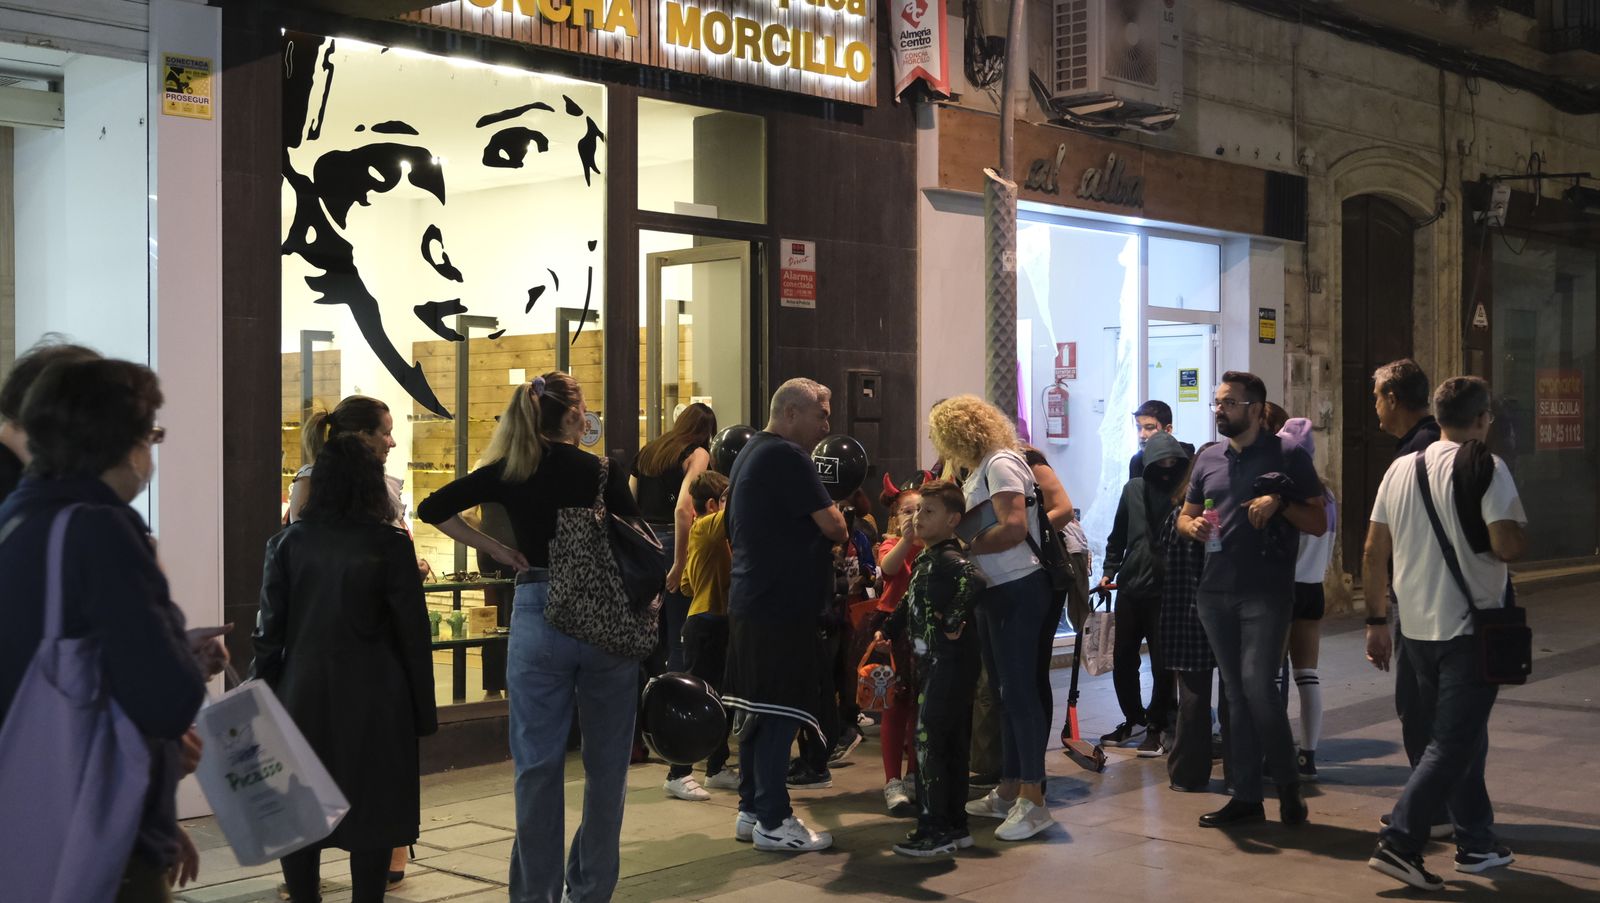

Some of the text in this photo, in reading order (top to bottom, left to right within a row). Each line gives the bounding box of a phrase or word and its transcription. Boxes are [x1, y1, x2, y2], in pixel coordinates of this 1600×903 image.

[900, 27, 931, 40] Almería
[666, 2, 872, 82] MORCILLO
[900, 37, 932, 48] centro
[905, 50, 928, 60] CONCHA
[165, 93, 209, 105] PROSEGUR
[1024, 143, 1066, 195] al
[783, 270, 813, 282] Alarma
[1540, 401, 1580, 415] SE ALQUILA
